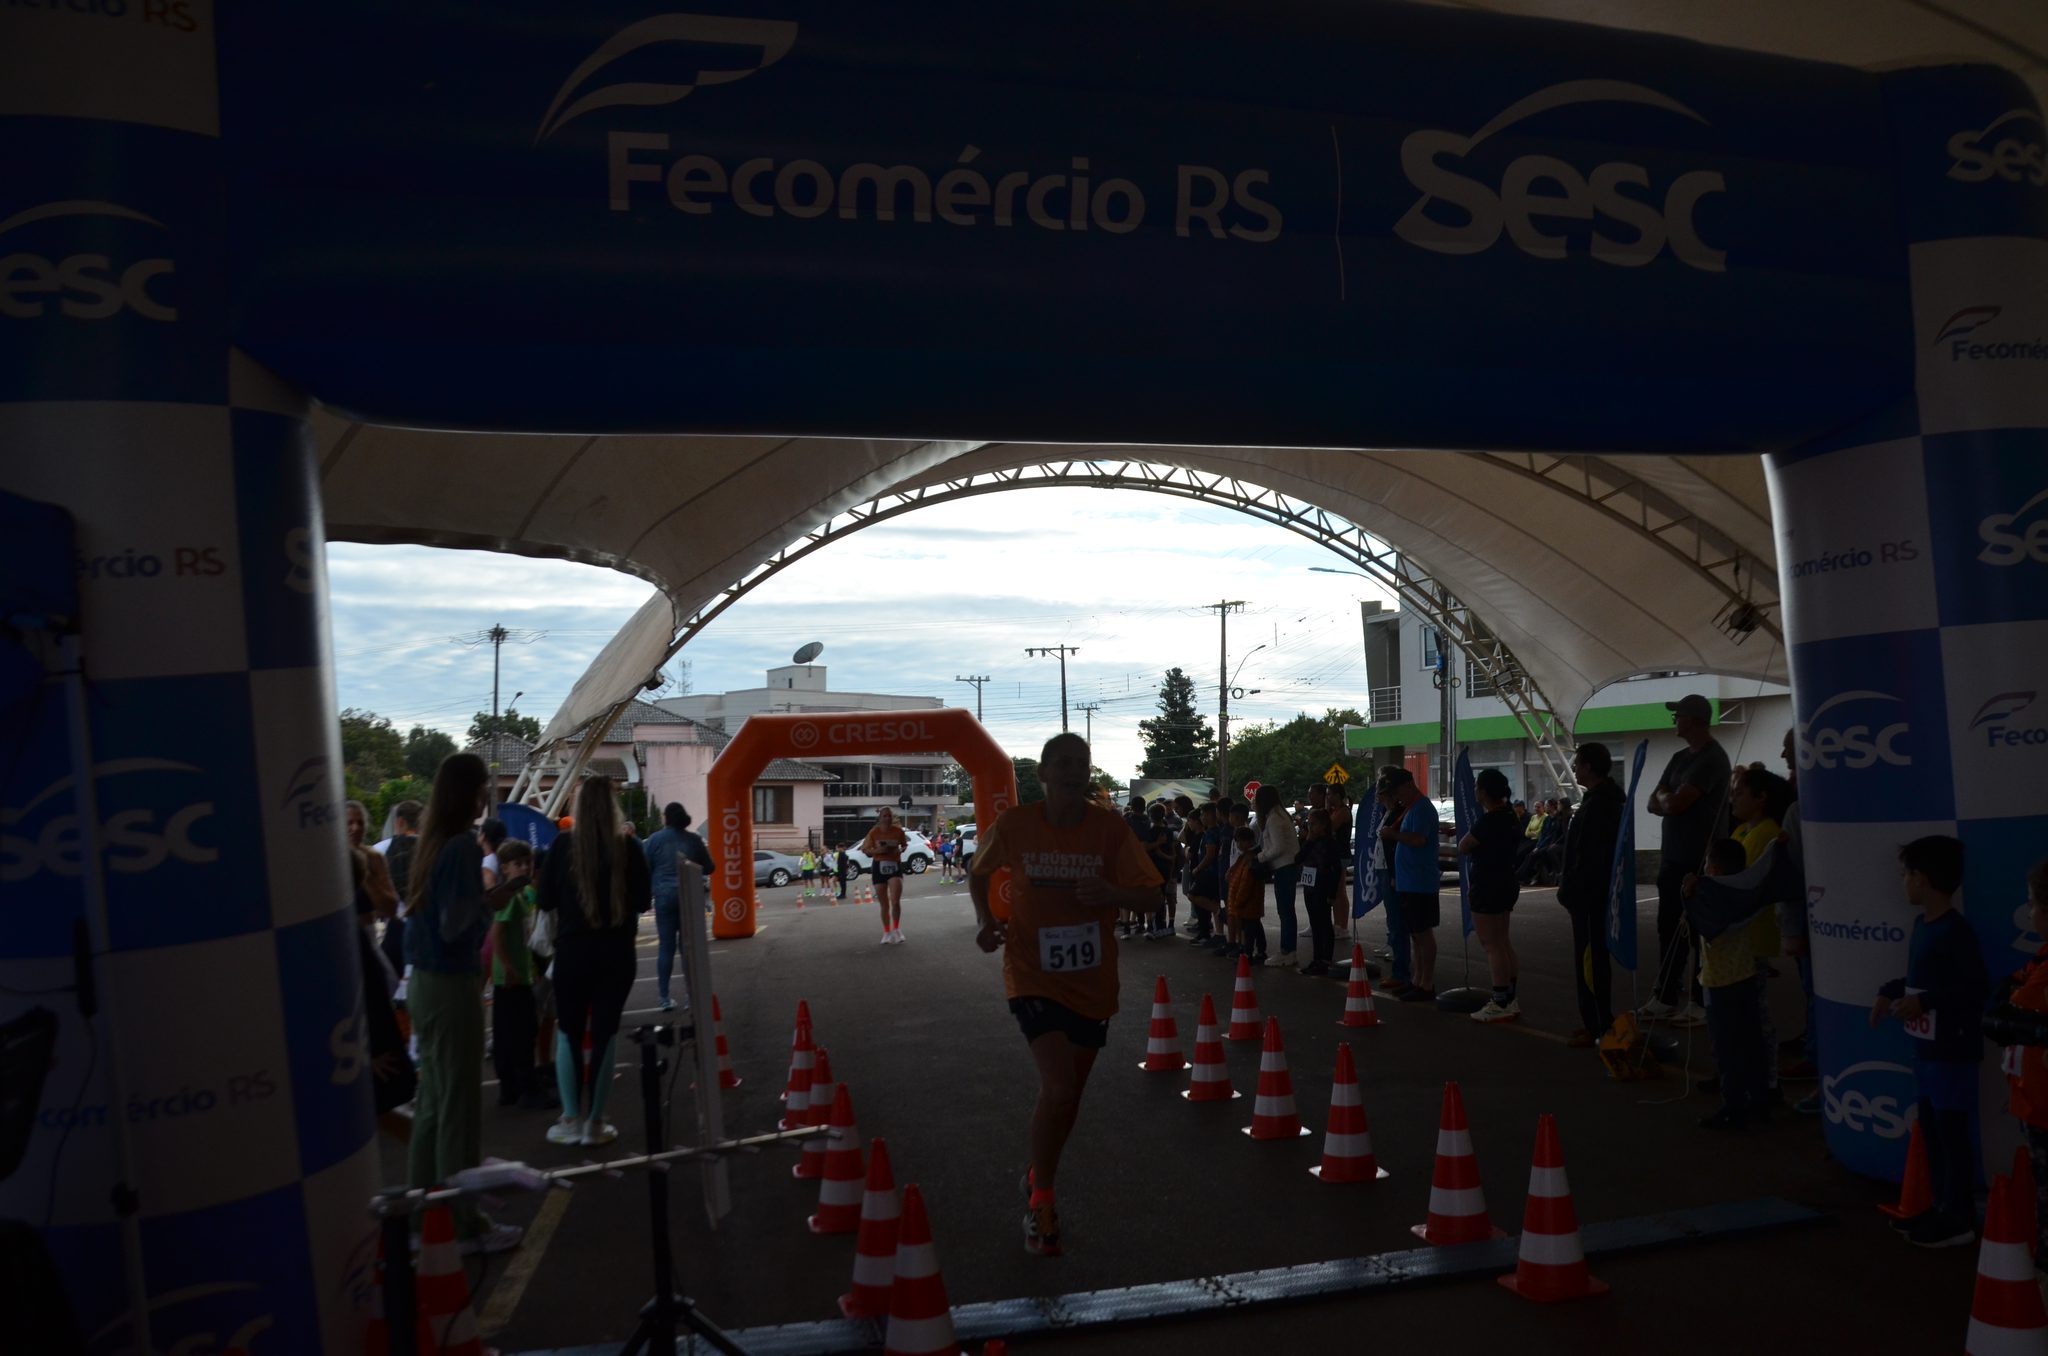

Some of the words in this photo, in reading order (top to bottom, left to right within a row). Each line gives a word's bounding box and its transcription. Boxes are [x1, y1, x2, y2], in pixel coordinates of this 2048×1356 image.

[607, 131, 1146, 234] Fecomércio
[1175, 164, 1284, 242] RS
[1392, 128, 1727, 272] Sesc
[174, 547, 226, 576] RS
[1880, 540, 1919, 563] RS
[828, 719, 934, 745] CRESOL
[1244, 787, 1257, 797] PA
[722, 800, 742, 890] CRESOL
[1024, 864, 1100, 878] REGIONAL
[1050, 941, 1095, 969] 519
[228, 1069, 277, 1106] RS
